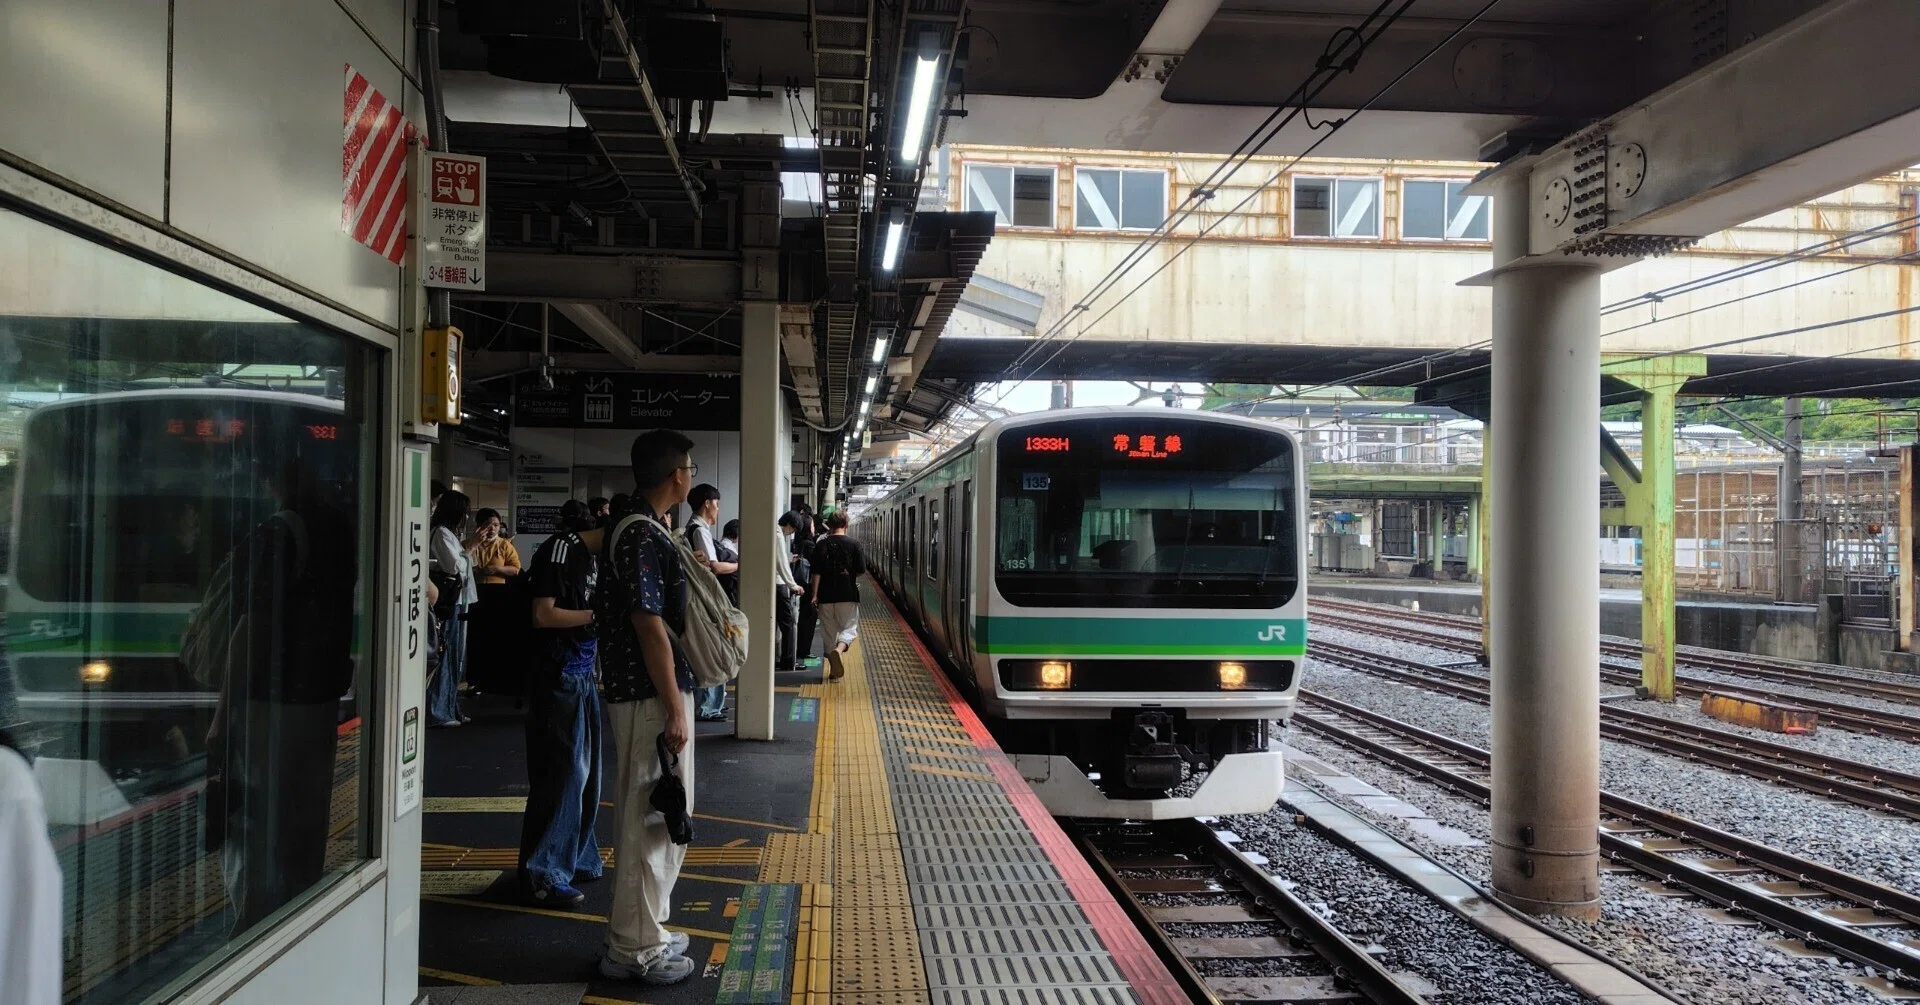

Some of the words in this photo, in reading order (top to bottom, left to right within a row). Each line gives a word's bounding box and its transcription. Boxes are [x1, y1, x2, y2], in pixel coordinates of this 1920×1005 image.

[435, 161, 477, 175] STOP
[432, 207, 479, 222] 非常停止
[441, 244, 460, 253] Train
[461, 247, 479, 255] Stop
[454, 253, 479, 262] Button
[631, 388, 731, 405] エレベーター
[630, 406, 674, 418] Elevator
[1026, 437, 1069, 452] 1333H
[1114, 434, 1181, 452] 常磐線
[1151, 449, 1168, 458] Line
[1026, 477, 1048, 489] 135
[1007, 559, 1026, 569] 135
[1257, 625, 1286, 641] JR
[406, 737, 414, 753] 02
